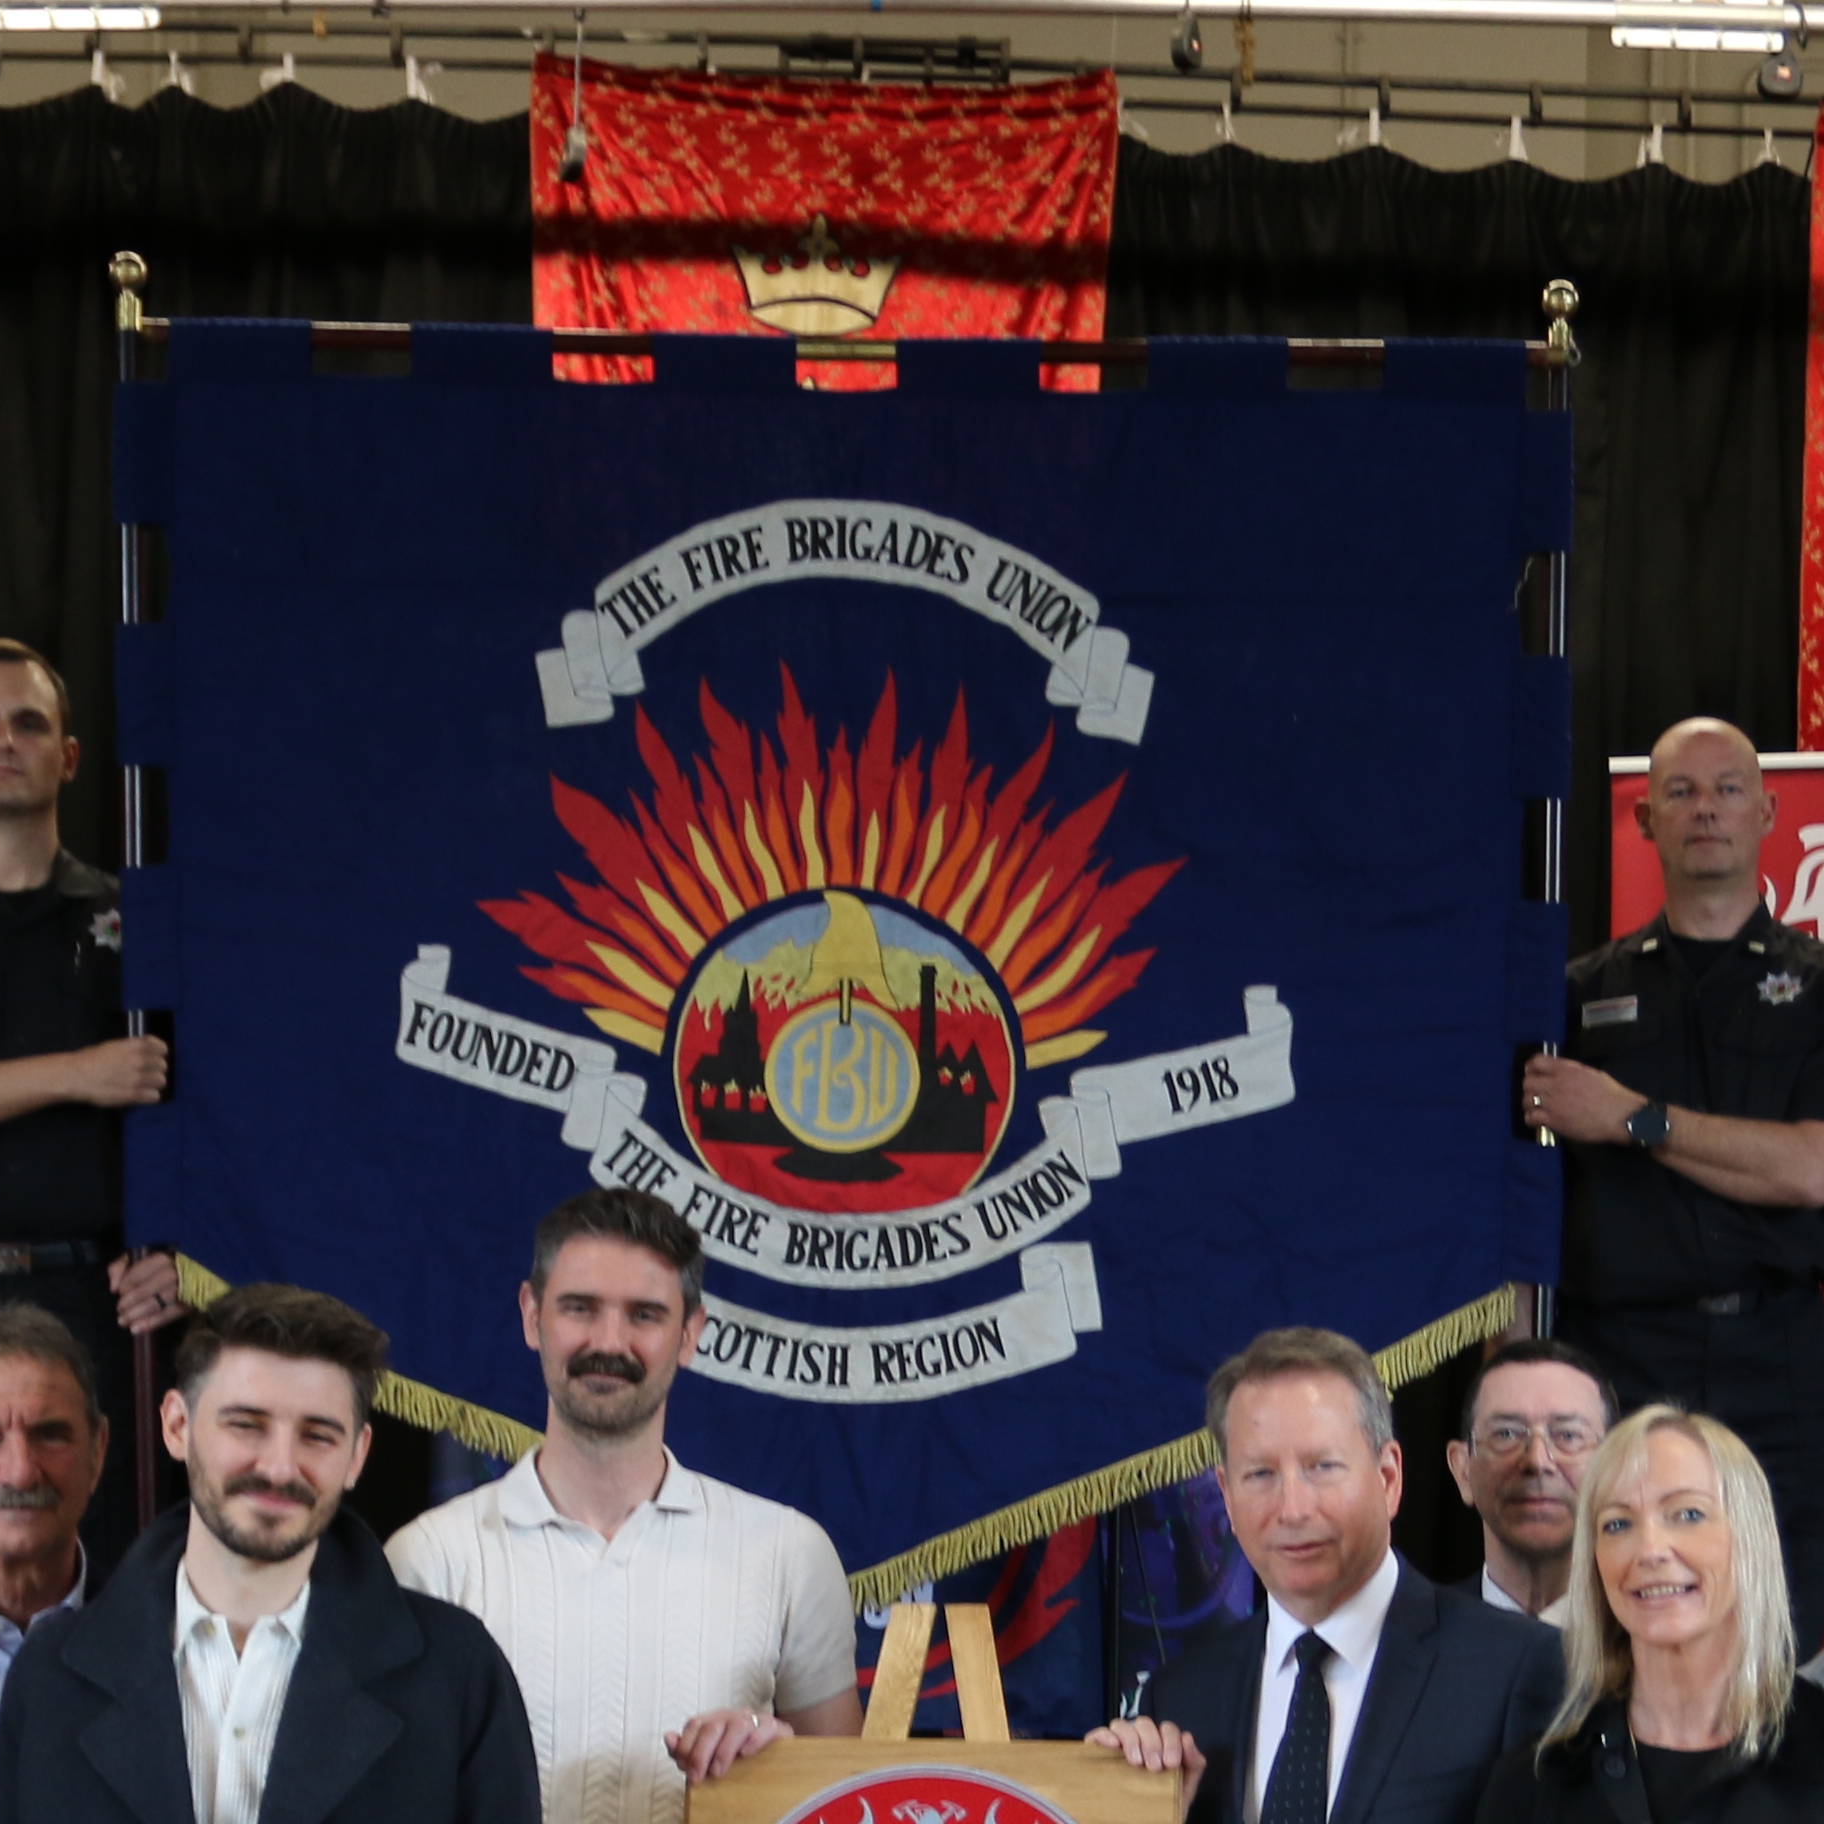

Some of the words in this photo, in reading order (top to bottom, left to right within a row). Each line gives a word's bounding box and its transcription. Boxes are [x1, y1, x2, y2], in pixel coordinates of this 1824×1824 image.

[598, 565, 677, 640] THE
[679, 525, 770, 592] FIRE
[785, 516, 975, 586] BRIGADES
[986, 556, 1092, 654] UNION
[404, 1000, 577, 1092] FOUNDED
[1162, 1056, 1239, 1115] 1918
[681, 1182, 770, 1256] FIRE
[784, 1212, 971, 1272] BRIGADES
[973, 1147, 1087, 1241] UNION
[869, 1316, 1007, 1385] REGION
